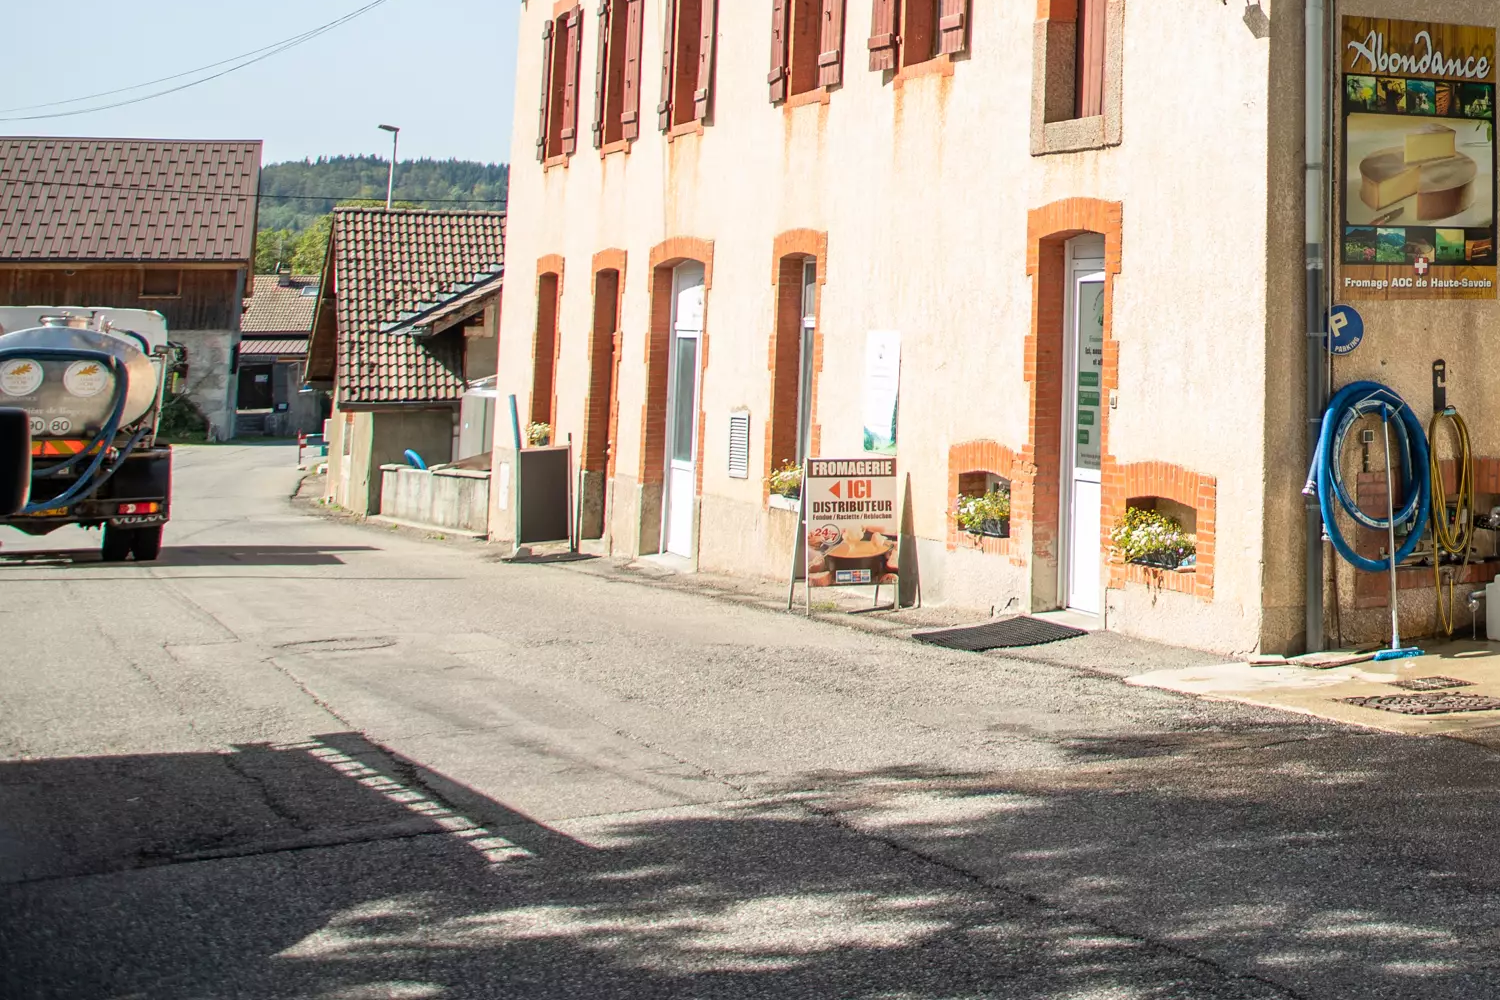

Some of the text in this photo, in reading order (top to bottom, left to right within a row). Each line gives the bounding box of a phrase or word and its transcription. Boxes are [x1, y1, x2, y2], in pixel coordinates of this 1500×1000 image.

[1347, 30, 1491, 78] Abondance
[1344, 277, 1492, 290] Fromage AOC de Haute-Savoie
[1329, 311, 1348, 338] P
[1334, 336, 1360, 352] PARKING
[52, 420, 70, 431] 80
[812, 461, 892, 476] FROMAGERIE
[847, 480, 872, 499] ICI
[813, 500, 892, 513] DISTRIBUTEUR
